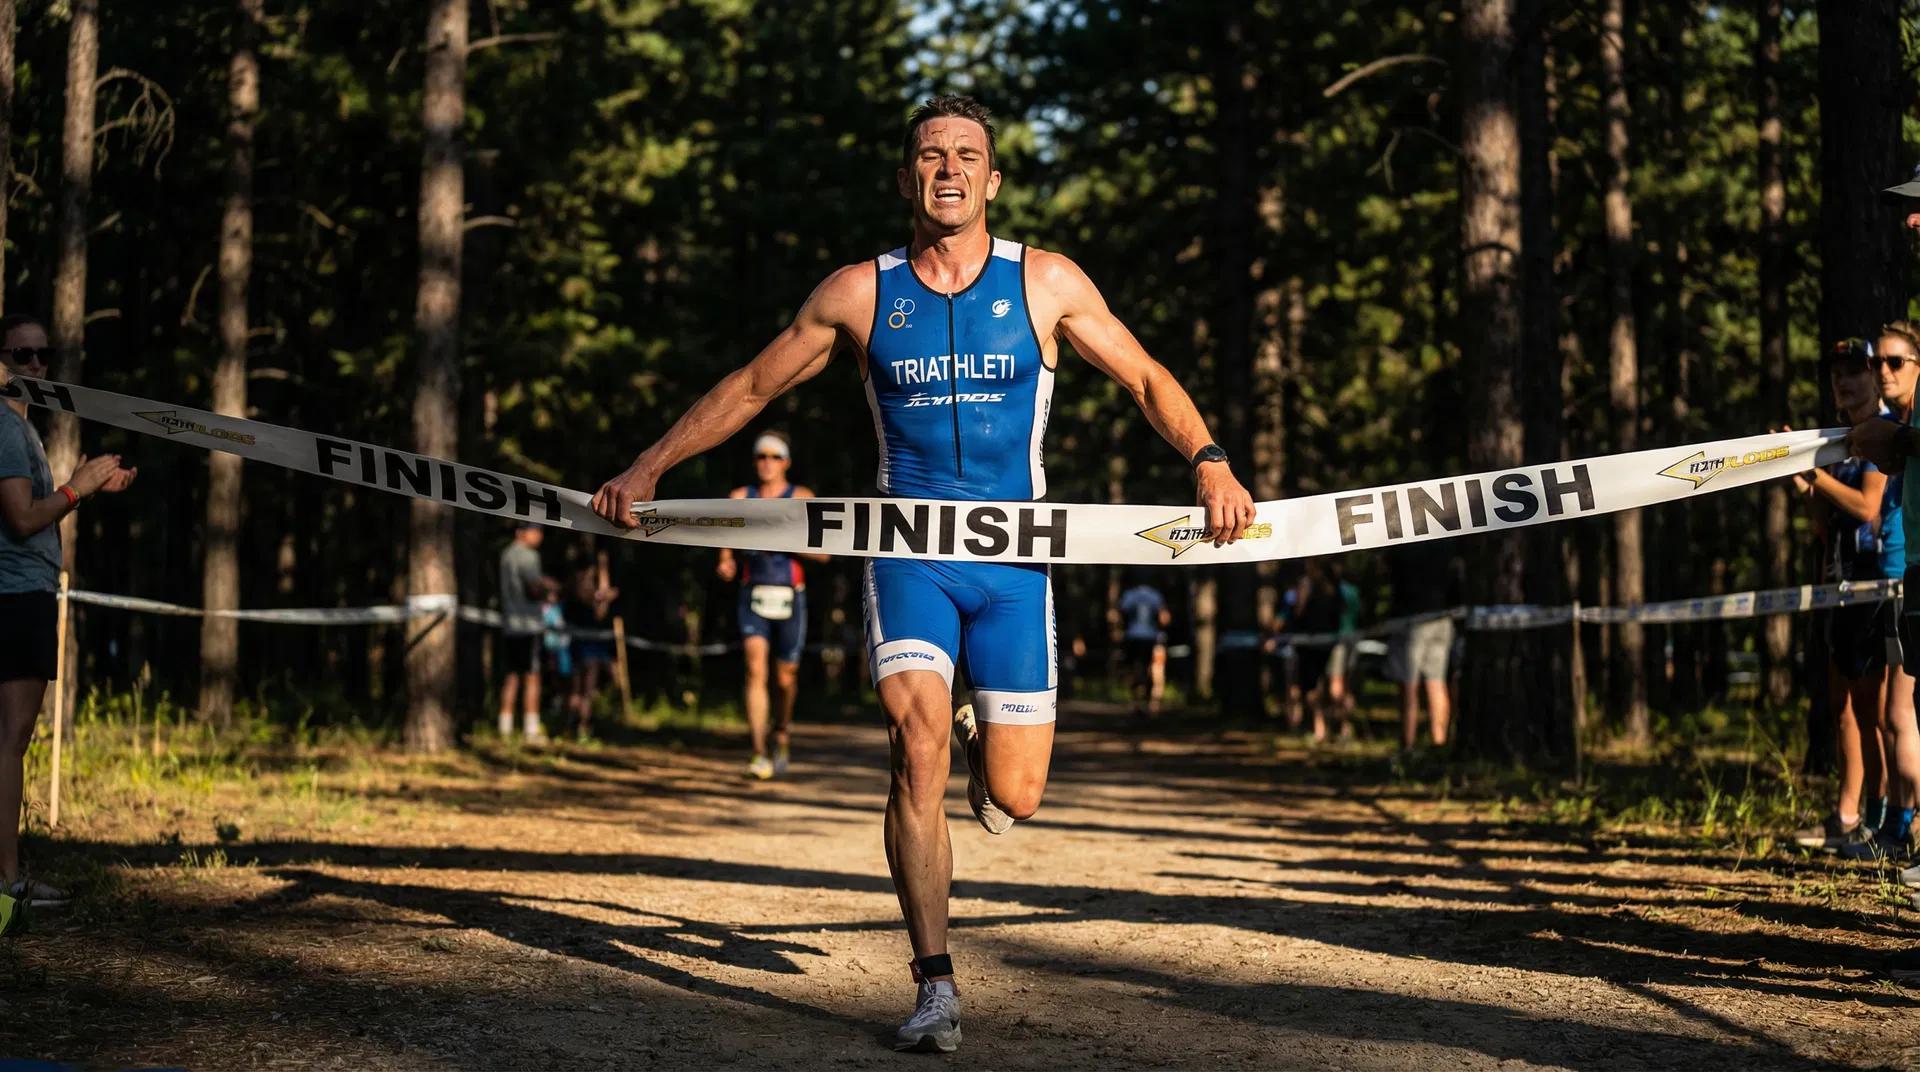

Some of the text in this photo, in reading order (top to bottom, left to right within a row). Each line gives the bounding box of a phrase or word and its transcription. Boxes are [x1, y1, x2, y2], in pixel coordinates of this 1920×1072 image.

[890, 353, 1015, 385] TRIATHLETI
[316, 437, 561, 522] FINISH
[1335, 464, 1595, 546] FINISH
[806, 502, 1066, 558] FINISH
